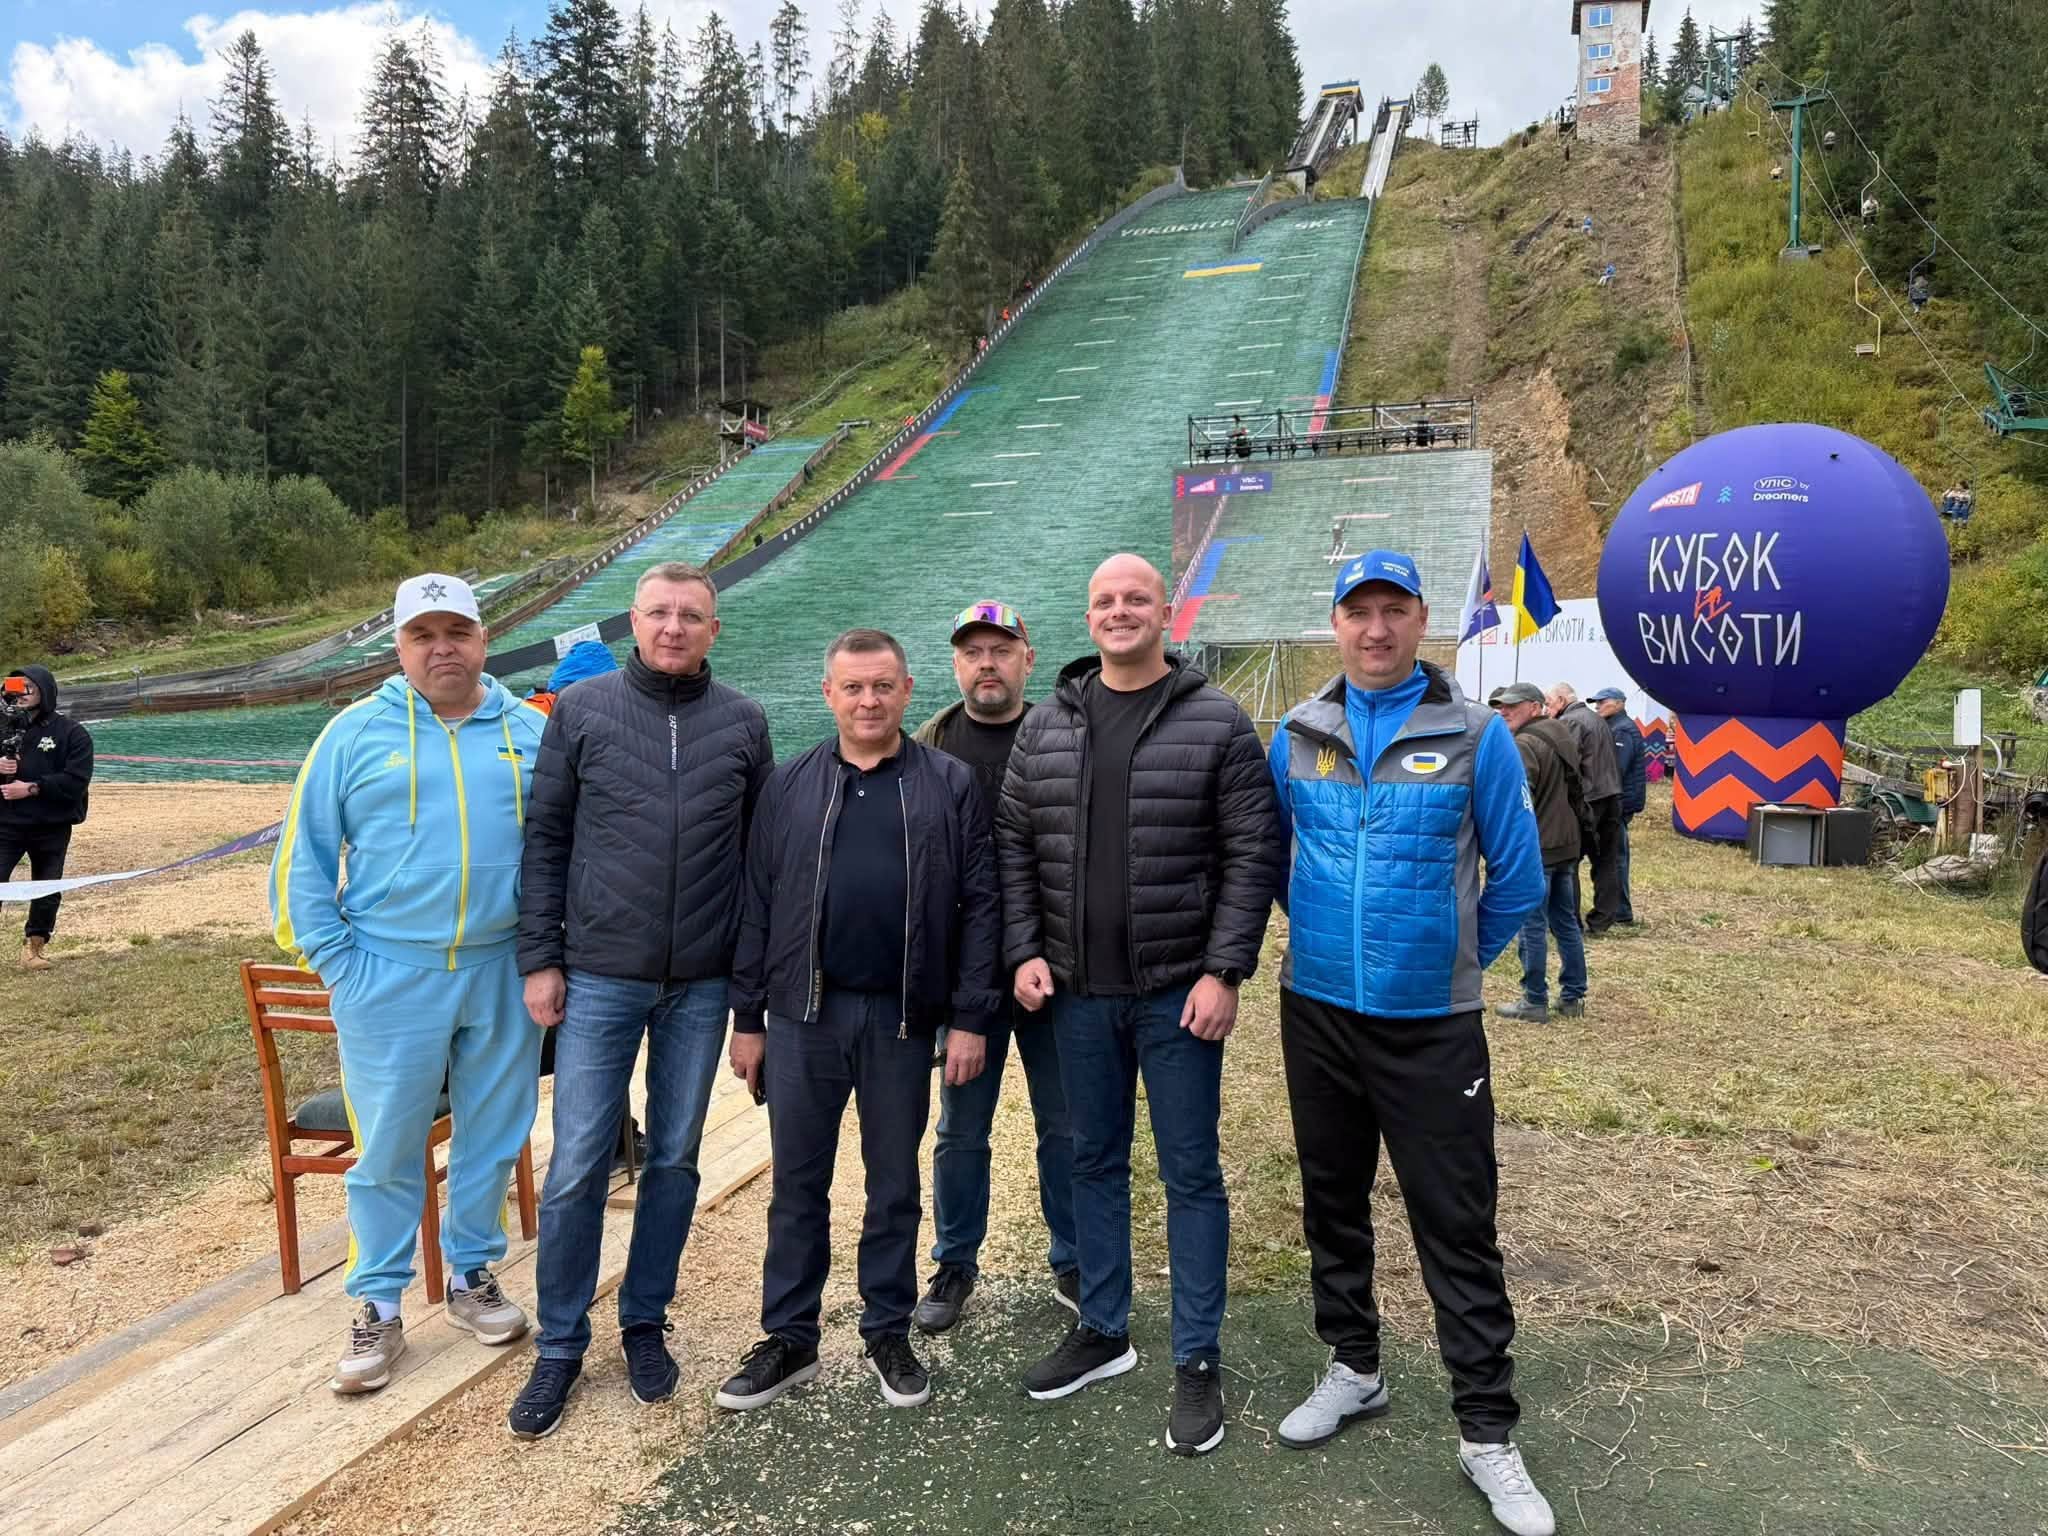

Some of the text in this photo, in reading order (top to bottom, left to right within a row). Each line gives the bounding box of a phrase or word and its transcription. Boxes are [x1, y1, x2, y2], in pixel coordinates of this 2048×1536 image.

[1753, 492, 1809, 503] Dreamers
[1649, 531, 1782, 593] КУБОК
[1638, 610, 1801, 666] ВИСОТИ
